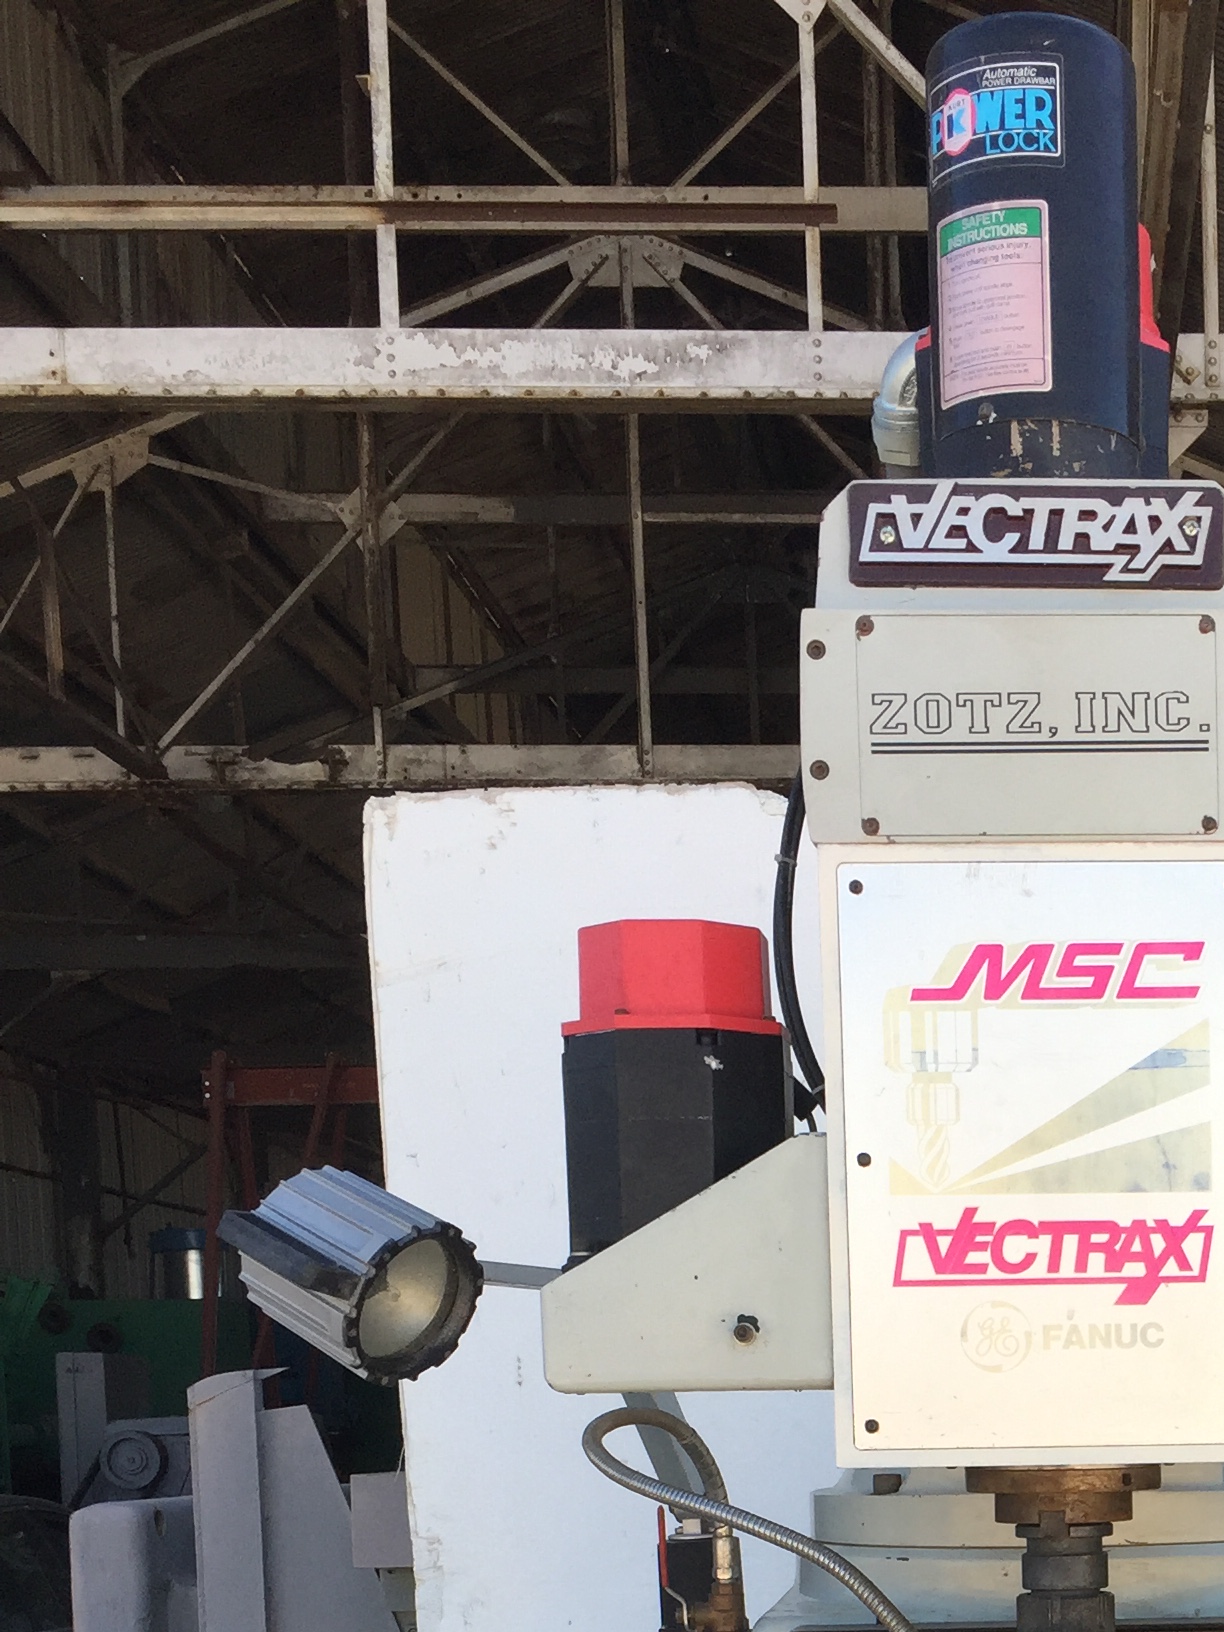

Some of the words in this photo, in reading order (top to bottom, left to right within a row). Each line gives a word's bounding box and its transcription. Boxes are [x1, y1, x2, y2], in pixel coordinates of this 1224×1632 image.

[982, 77, 1012, 88] POWER
[1013, 76, 1056, 86] DRAWBAR
[983, 66, 1038, 80] Automatic
[985, 130, 1057, 155] LOCK
[961, 210, 1006, 231] SAFETY
[947, 222, 1028, 252] INSTRUCTIONS
[889, 482, 1206, 572] VECTRAX
[869, 691, 1059, 739] ZOTZ,
[1074, 690, 1211, 733] INC.
[909, 940, 1206, 1002] MSC
[917, 1206, 1210, 1306] VECTRAX
[1042, 1322, 1165, 1351] FANUC
